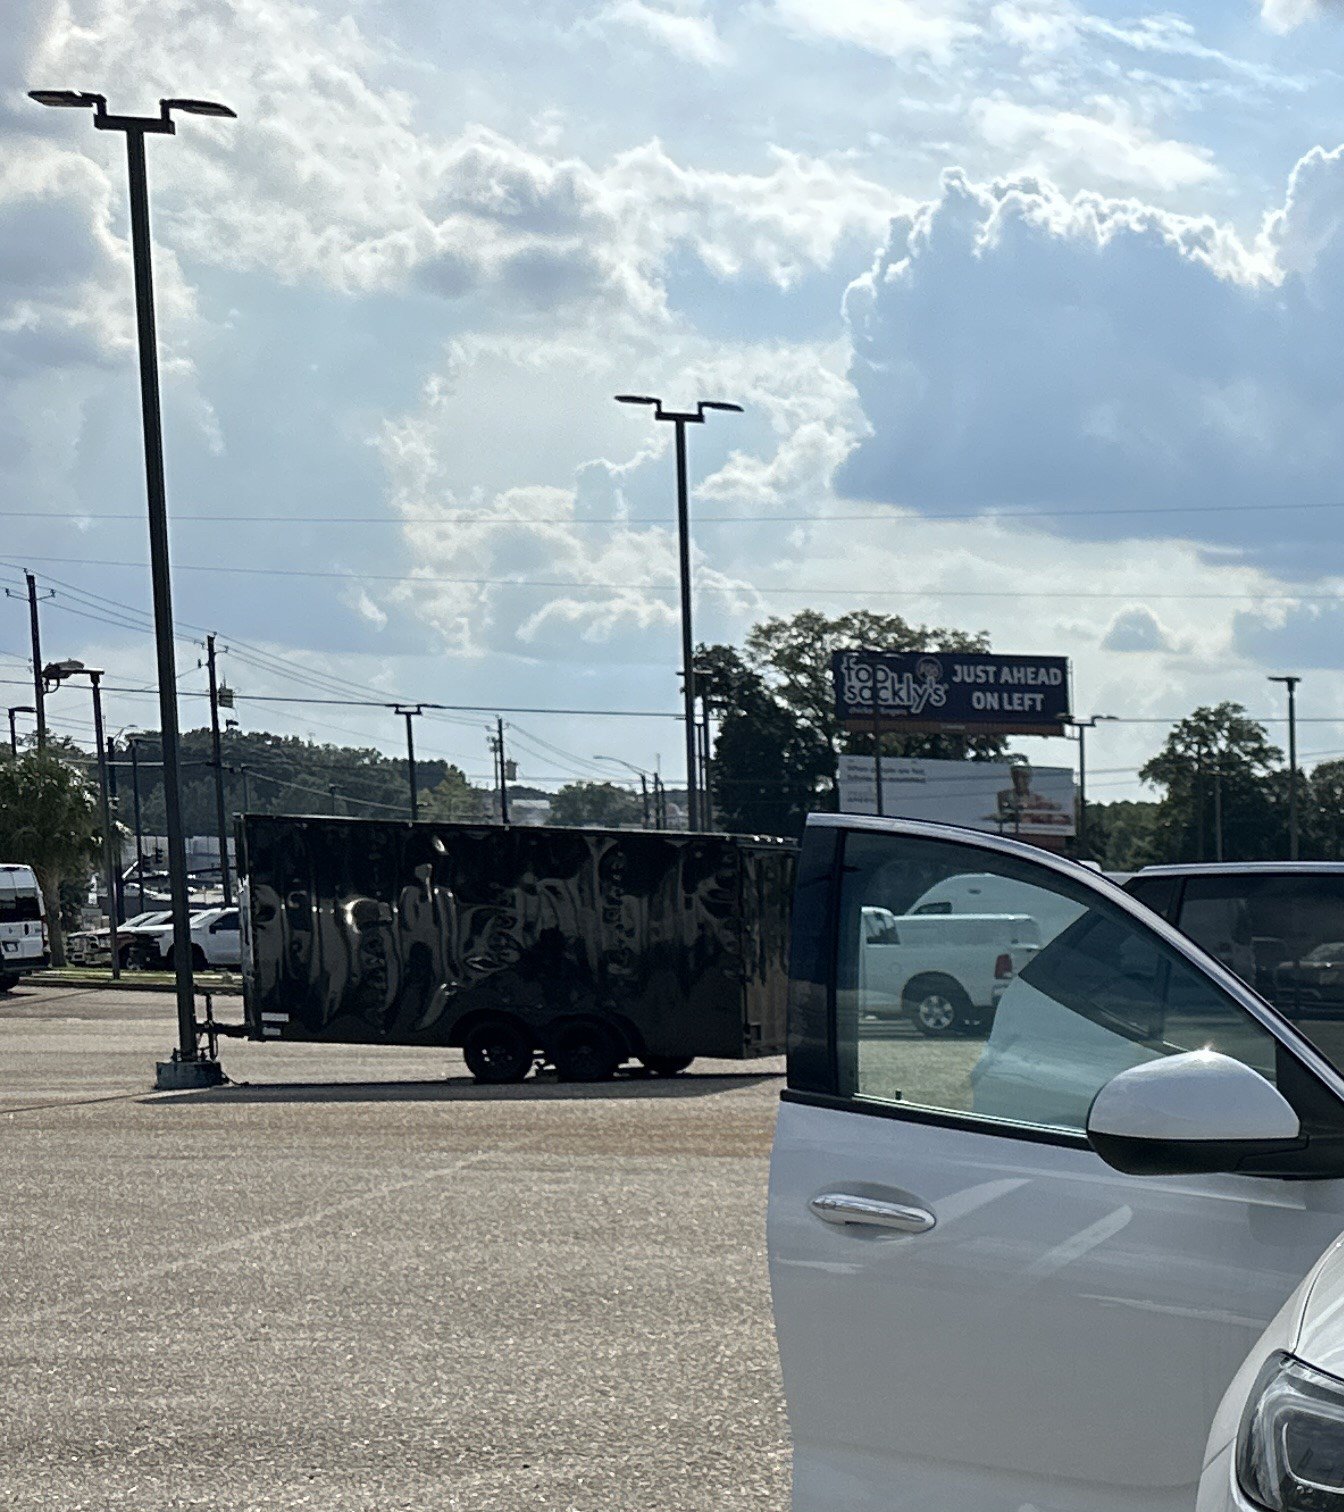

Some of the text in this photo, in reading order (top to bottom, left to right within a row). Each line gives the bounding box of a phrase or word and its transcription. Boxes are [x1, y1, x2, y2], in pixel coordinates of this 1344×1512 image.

[952, 665, 1062, 686] JUST AHEAD
[971, 691, 1044, 712] ON LEFT
